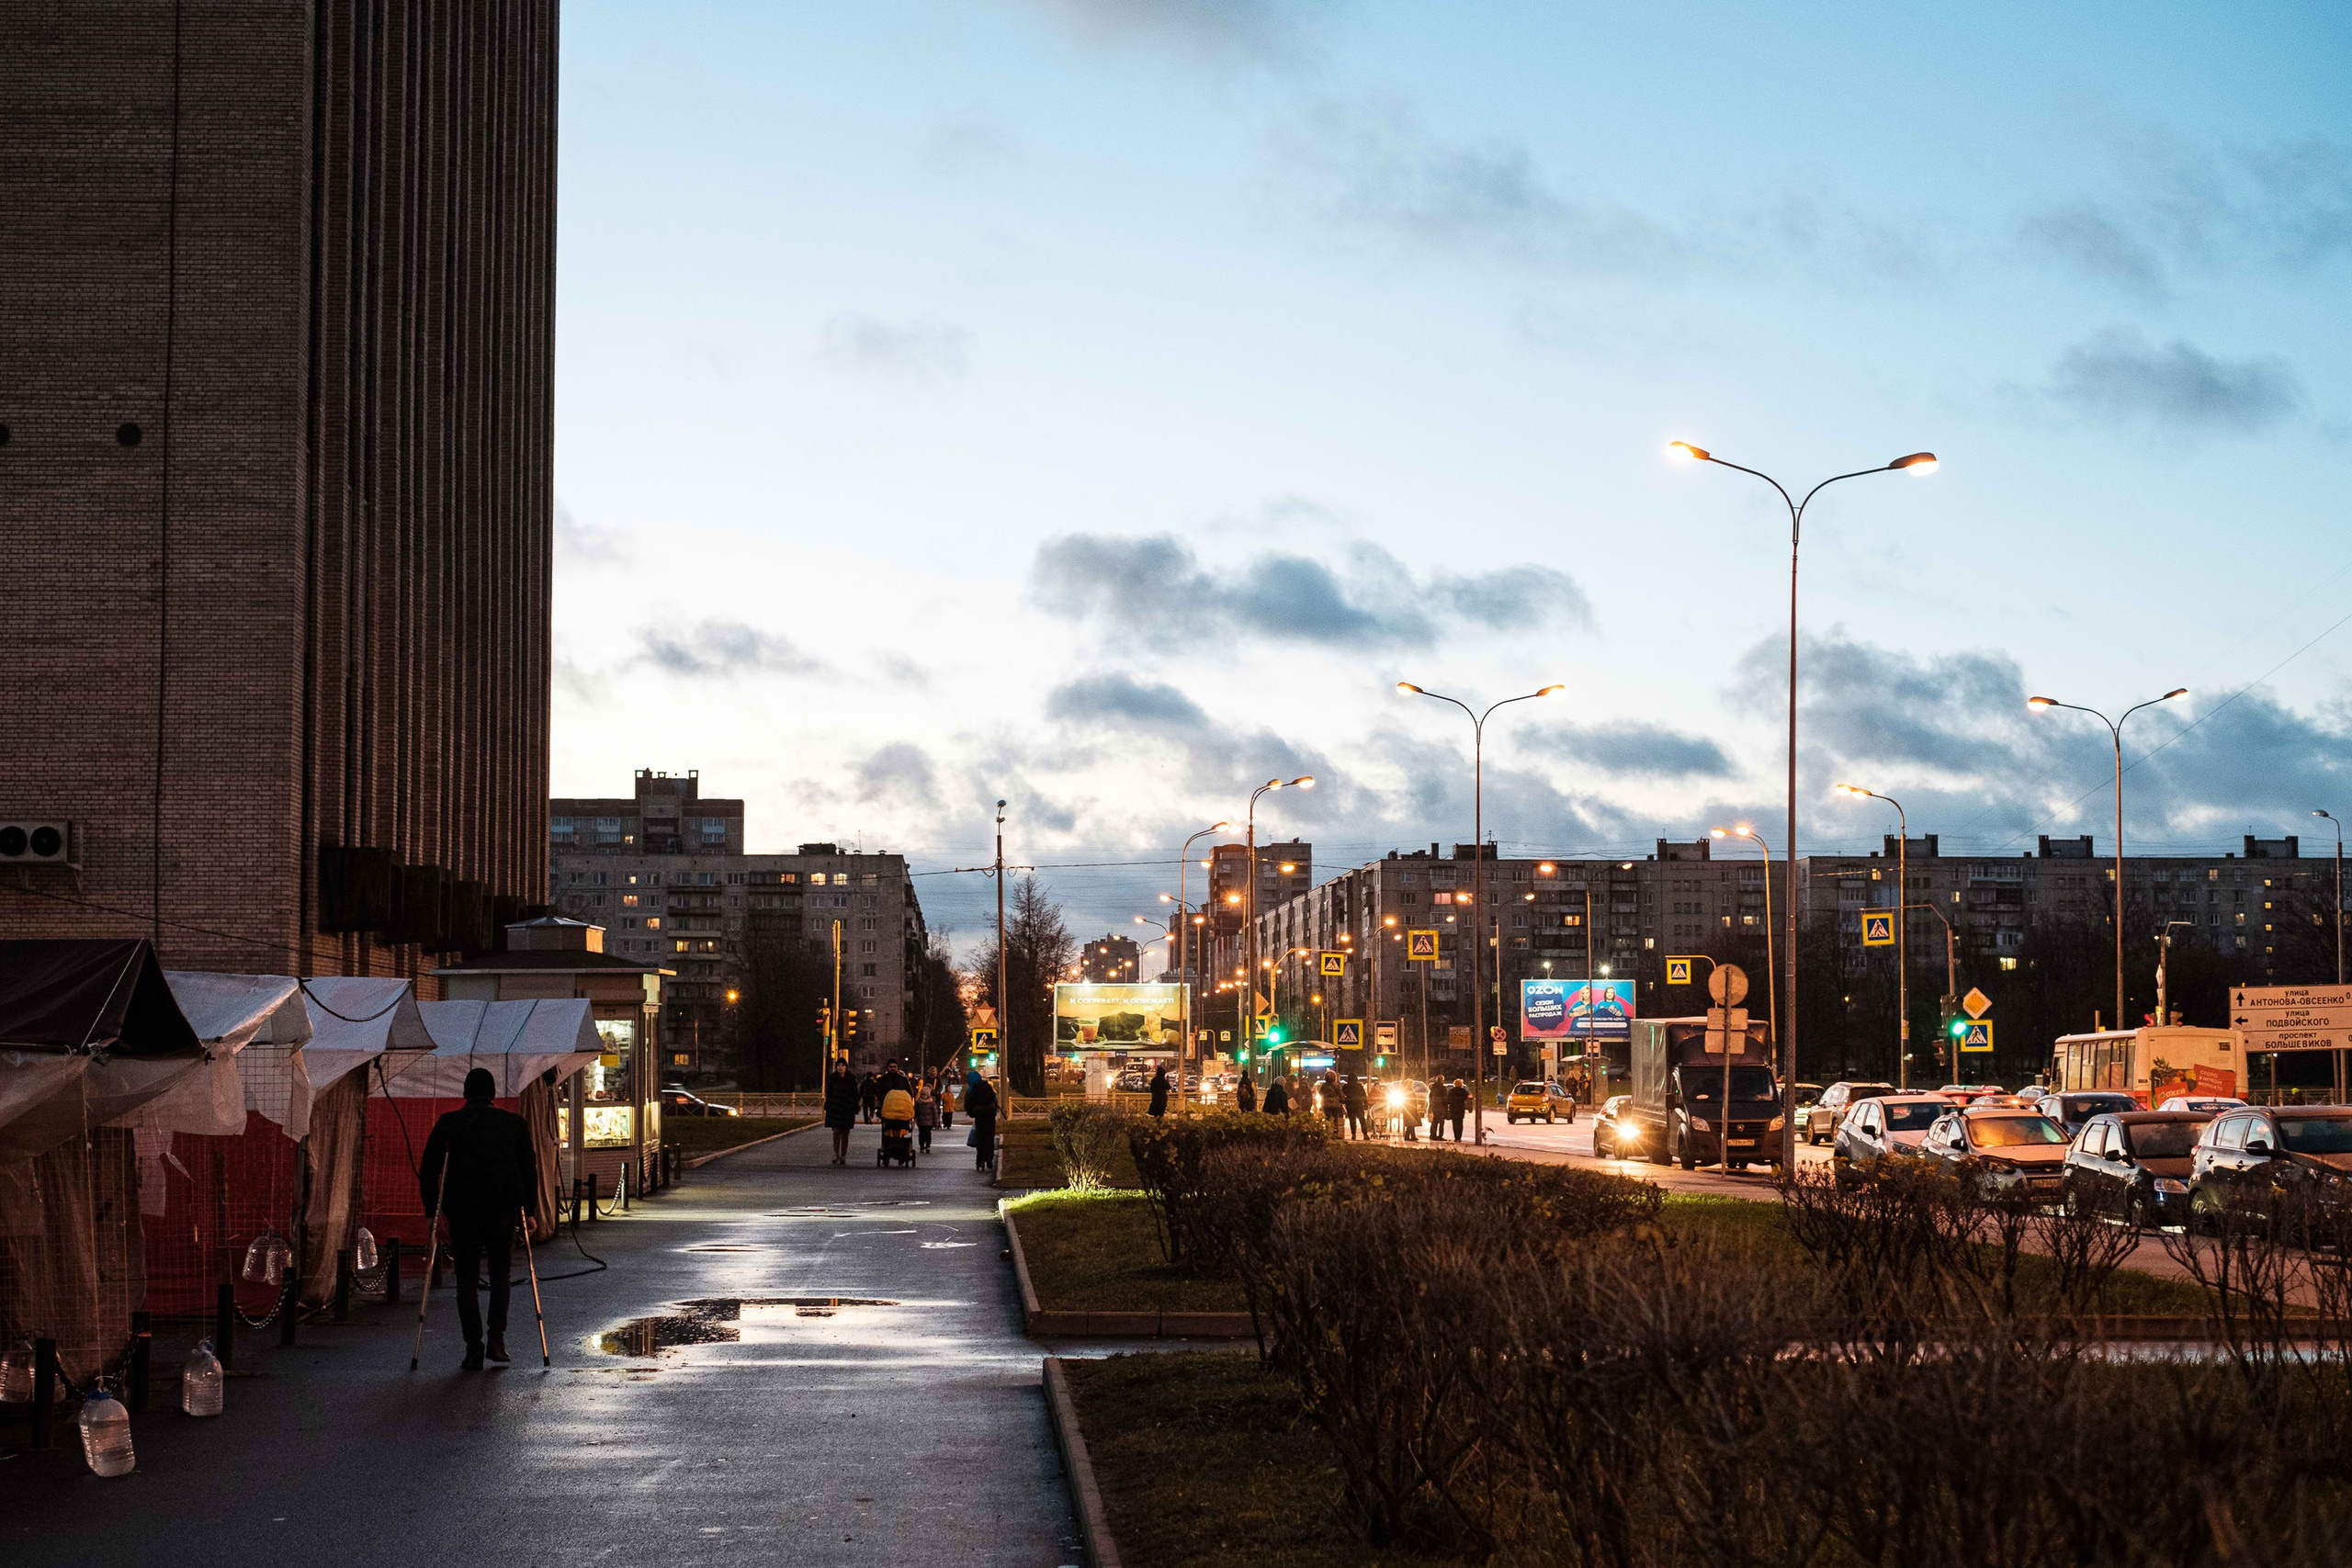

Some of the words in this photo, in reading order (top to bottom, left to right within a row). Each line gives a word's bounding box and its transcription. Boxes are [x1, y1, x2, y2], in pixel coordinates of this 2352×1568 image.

[1527, 986, 1564, 995] OZON
[2250, 997, 2345, 1007] АНТОНОВА-ОВСЕЕНКО
[1528, 1004, 1562, 1012] БОЛЬШИХ
[2285, 1010, 2310, 1018] улица
[2266, 1017, 2329, 1028] ПОДВОЙСКОГО
[2265, 1039, 2332, 1049] БОЛЬШЕВИКОВ
[2199, 1069, 2218, 1078] СКОРО
